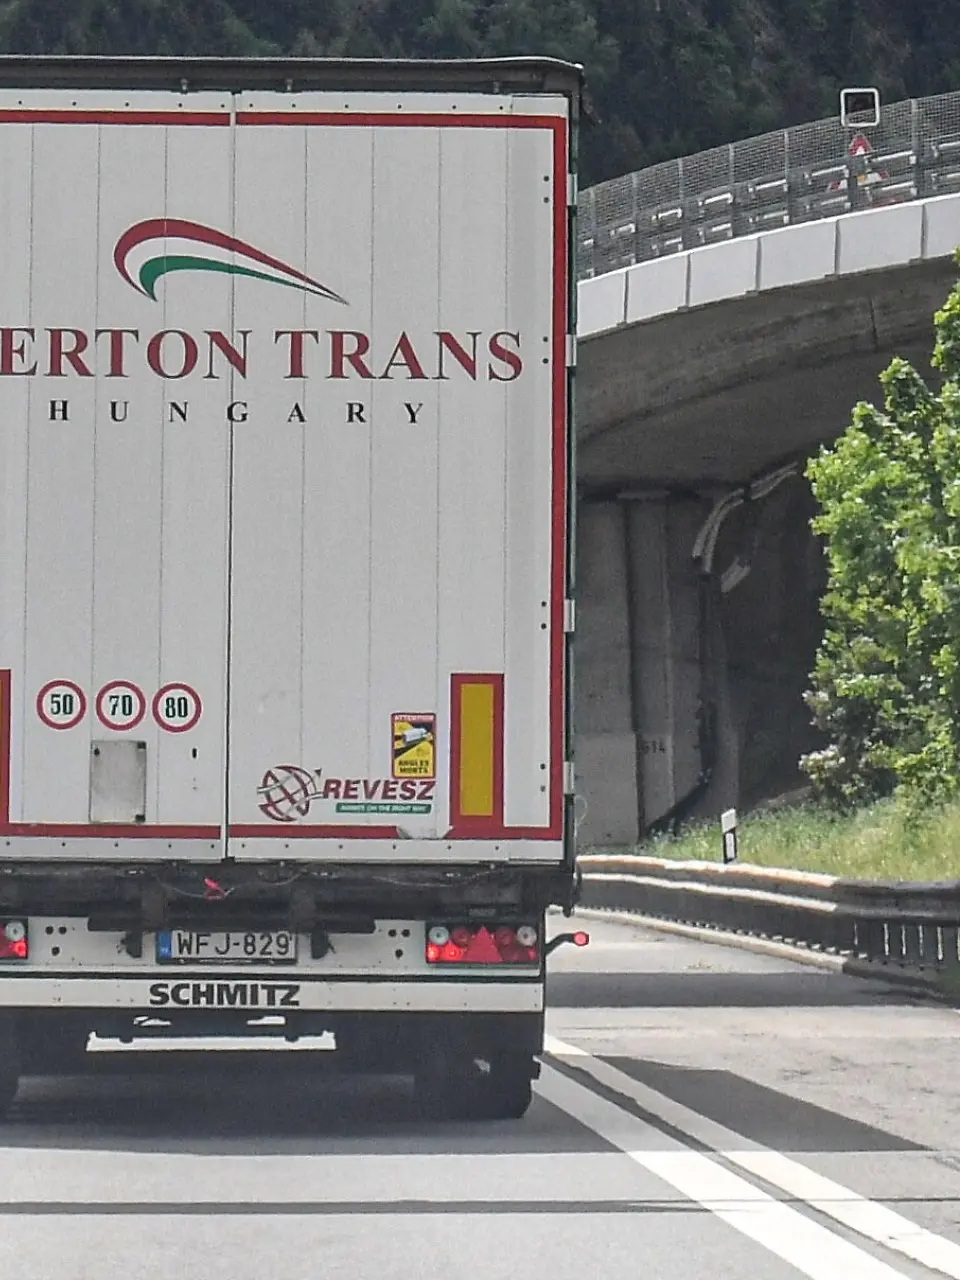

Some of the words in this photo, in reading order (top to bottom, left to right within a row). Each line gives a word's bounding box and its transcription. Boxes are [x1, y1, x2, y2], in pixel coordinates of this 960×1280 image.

[274, 330, 523, 382] TRANS
[48, 399, 424, 424] HUNGARY
[50, 693, 74, 715] 50
[109, 695, 133, 716] 70
[165, 697, 188, 718] 80
[323, 778, 437, 801] REVESZ
[149, 982, 300, 1007] SCHMITZ
